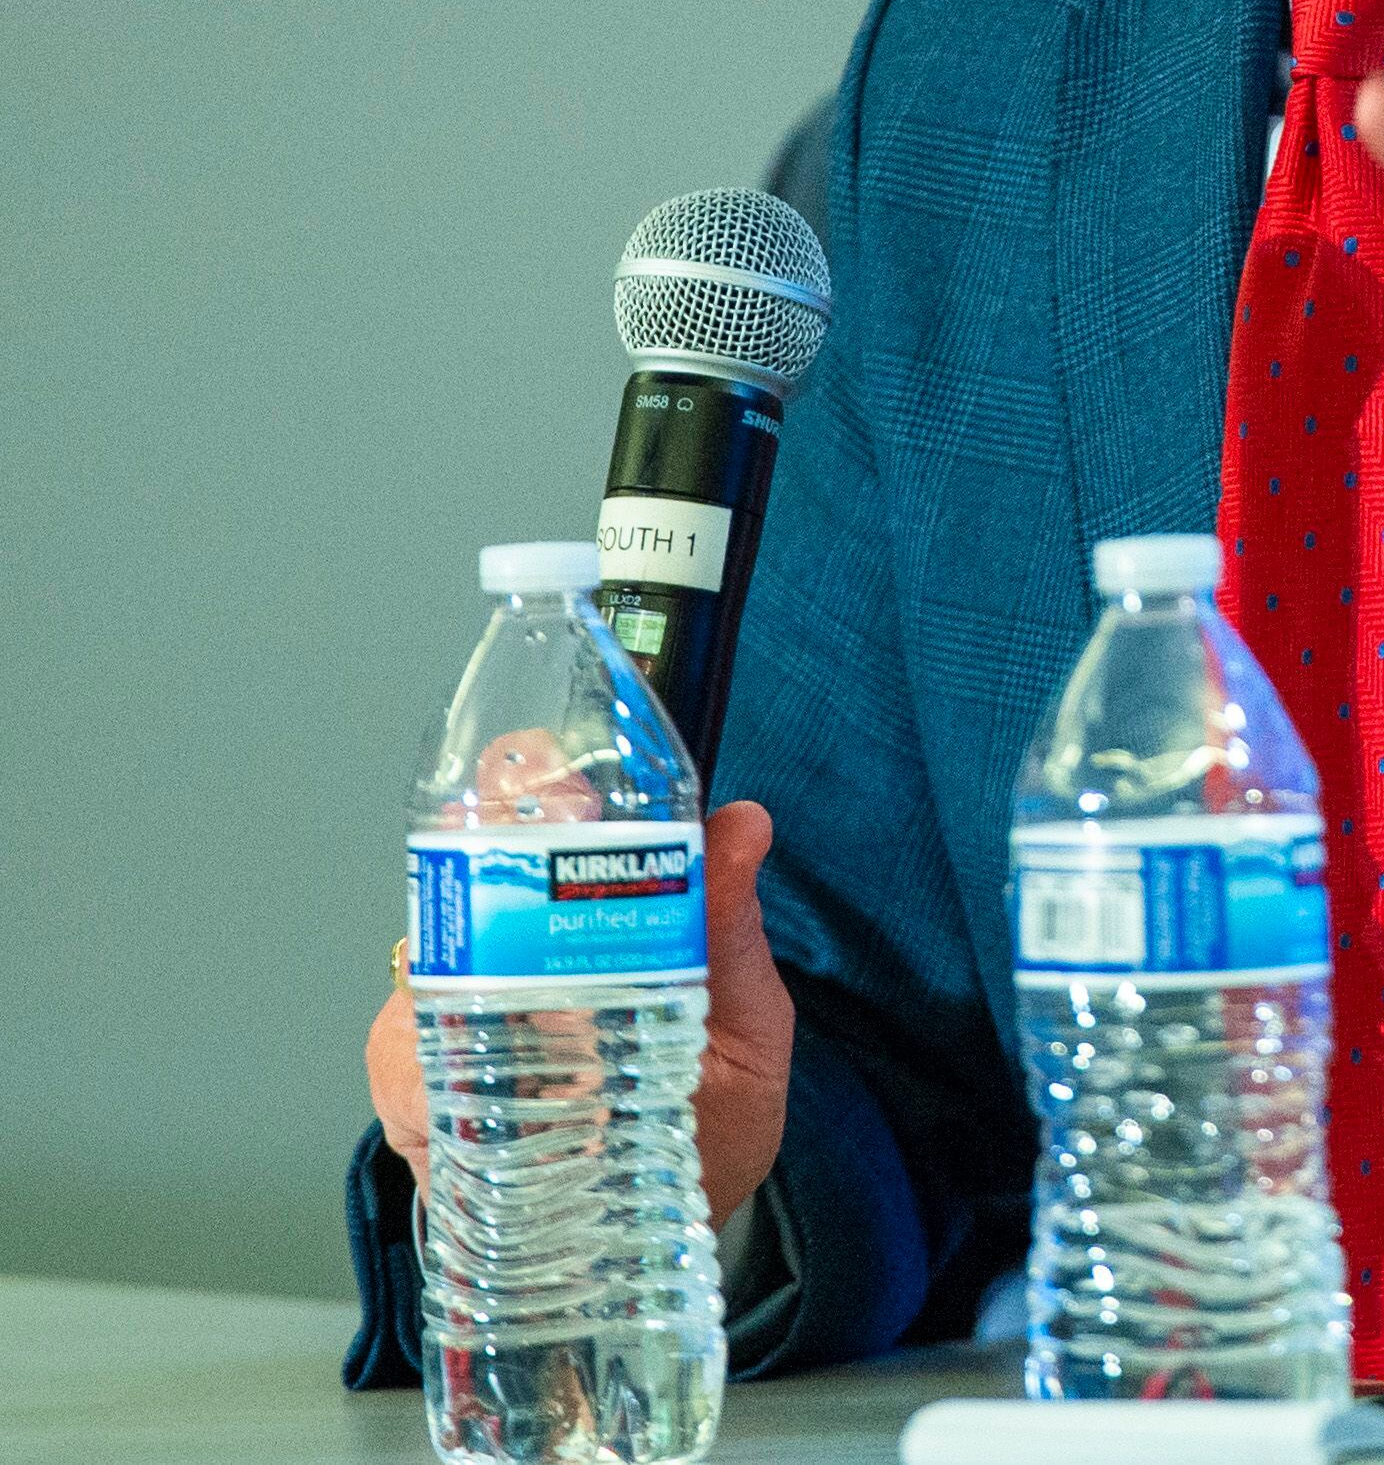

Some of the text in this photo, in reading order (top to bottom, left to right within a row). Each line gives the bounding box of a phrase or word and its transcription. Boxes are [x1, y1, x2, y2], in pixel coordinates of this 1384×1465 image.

[635, 394, 669, 409] SM58
[741, 409, 781, 439] SHUR
[597, 526, 696, 557] SOUTH 1
[556, 849, 687, 882] KIRKLAND
[550, 908, 638, 935] purified
